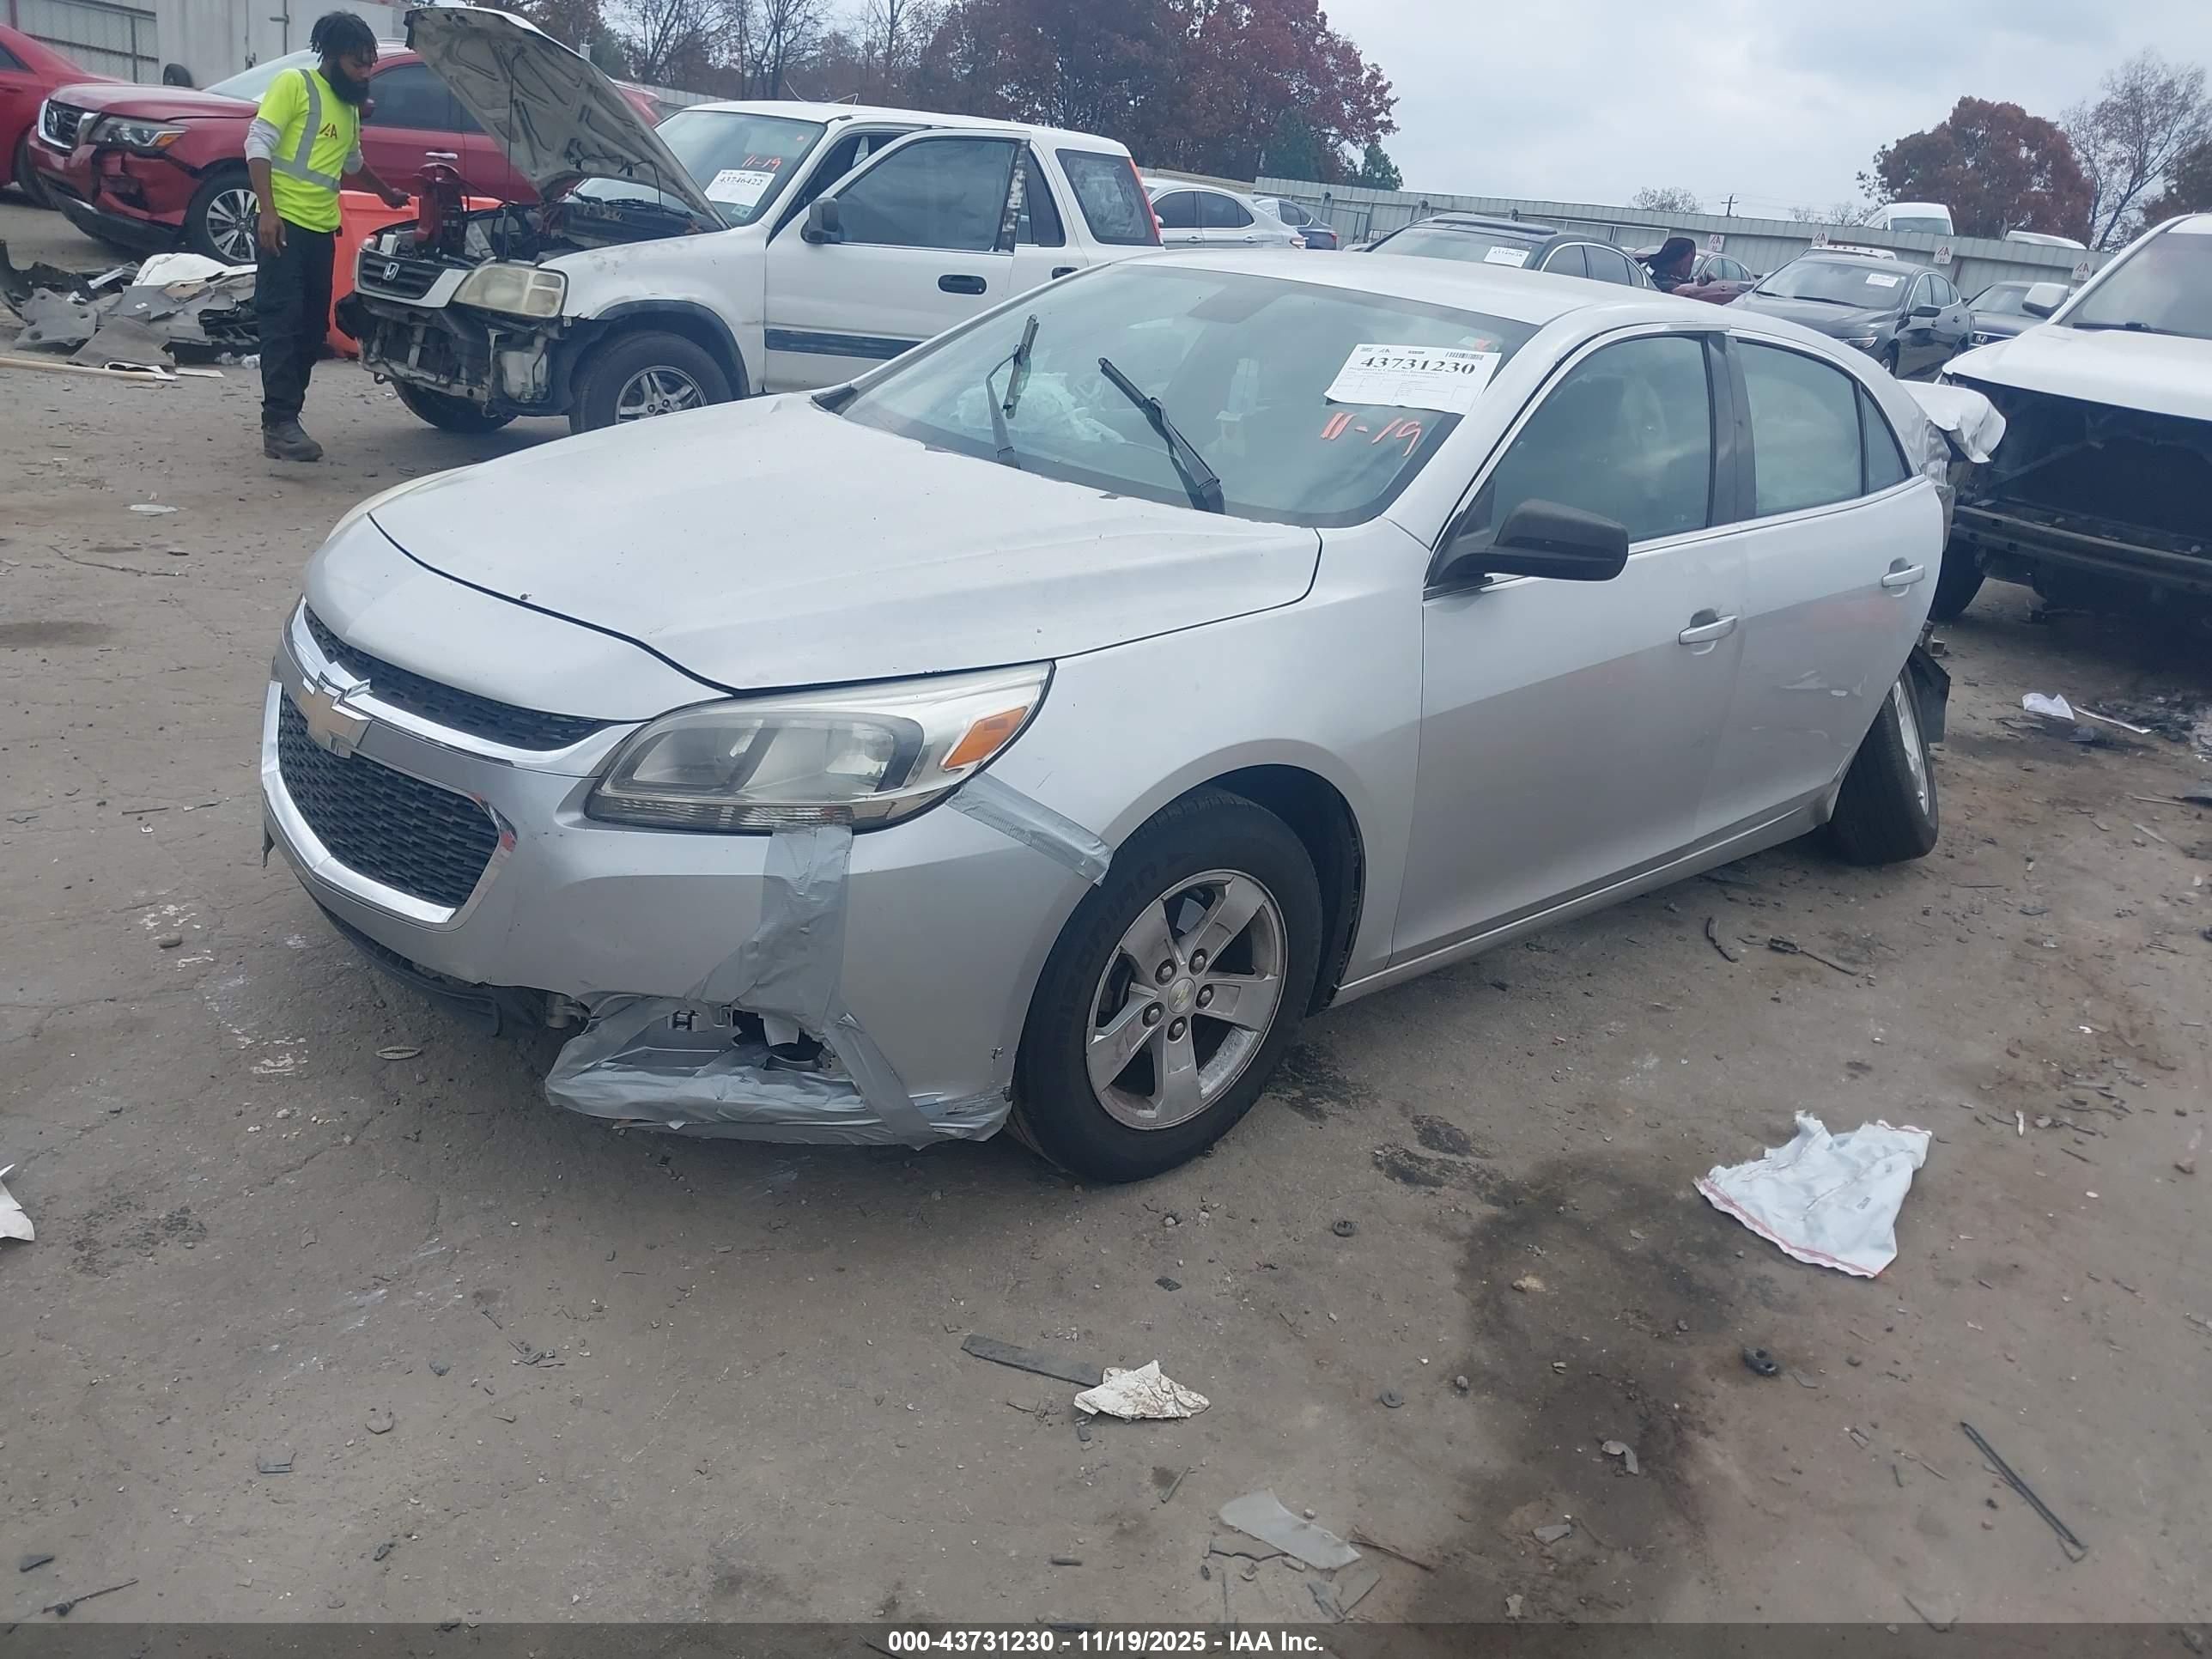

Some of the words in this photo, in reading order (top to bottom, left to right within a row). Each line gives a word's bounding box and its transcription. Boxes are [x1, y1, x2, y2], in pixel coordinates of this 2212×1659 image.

[741, 155, 782, 172] 11-19
[720, 176, 763, 186] 43746422
[1360, 356, 1476, 375] 43731230
[1320, 412, 1423, 458] 11-19
